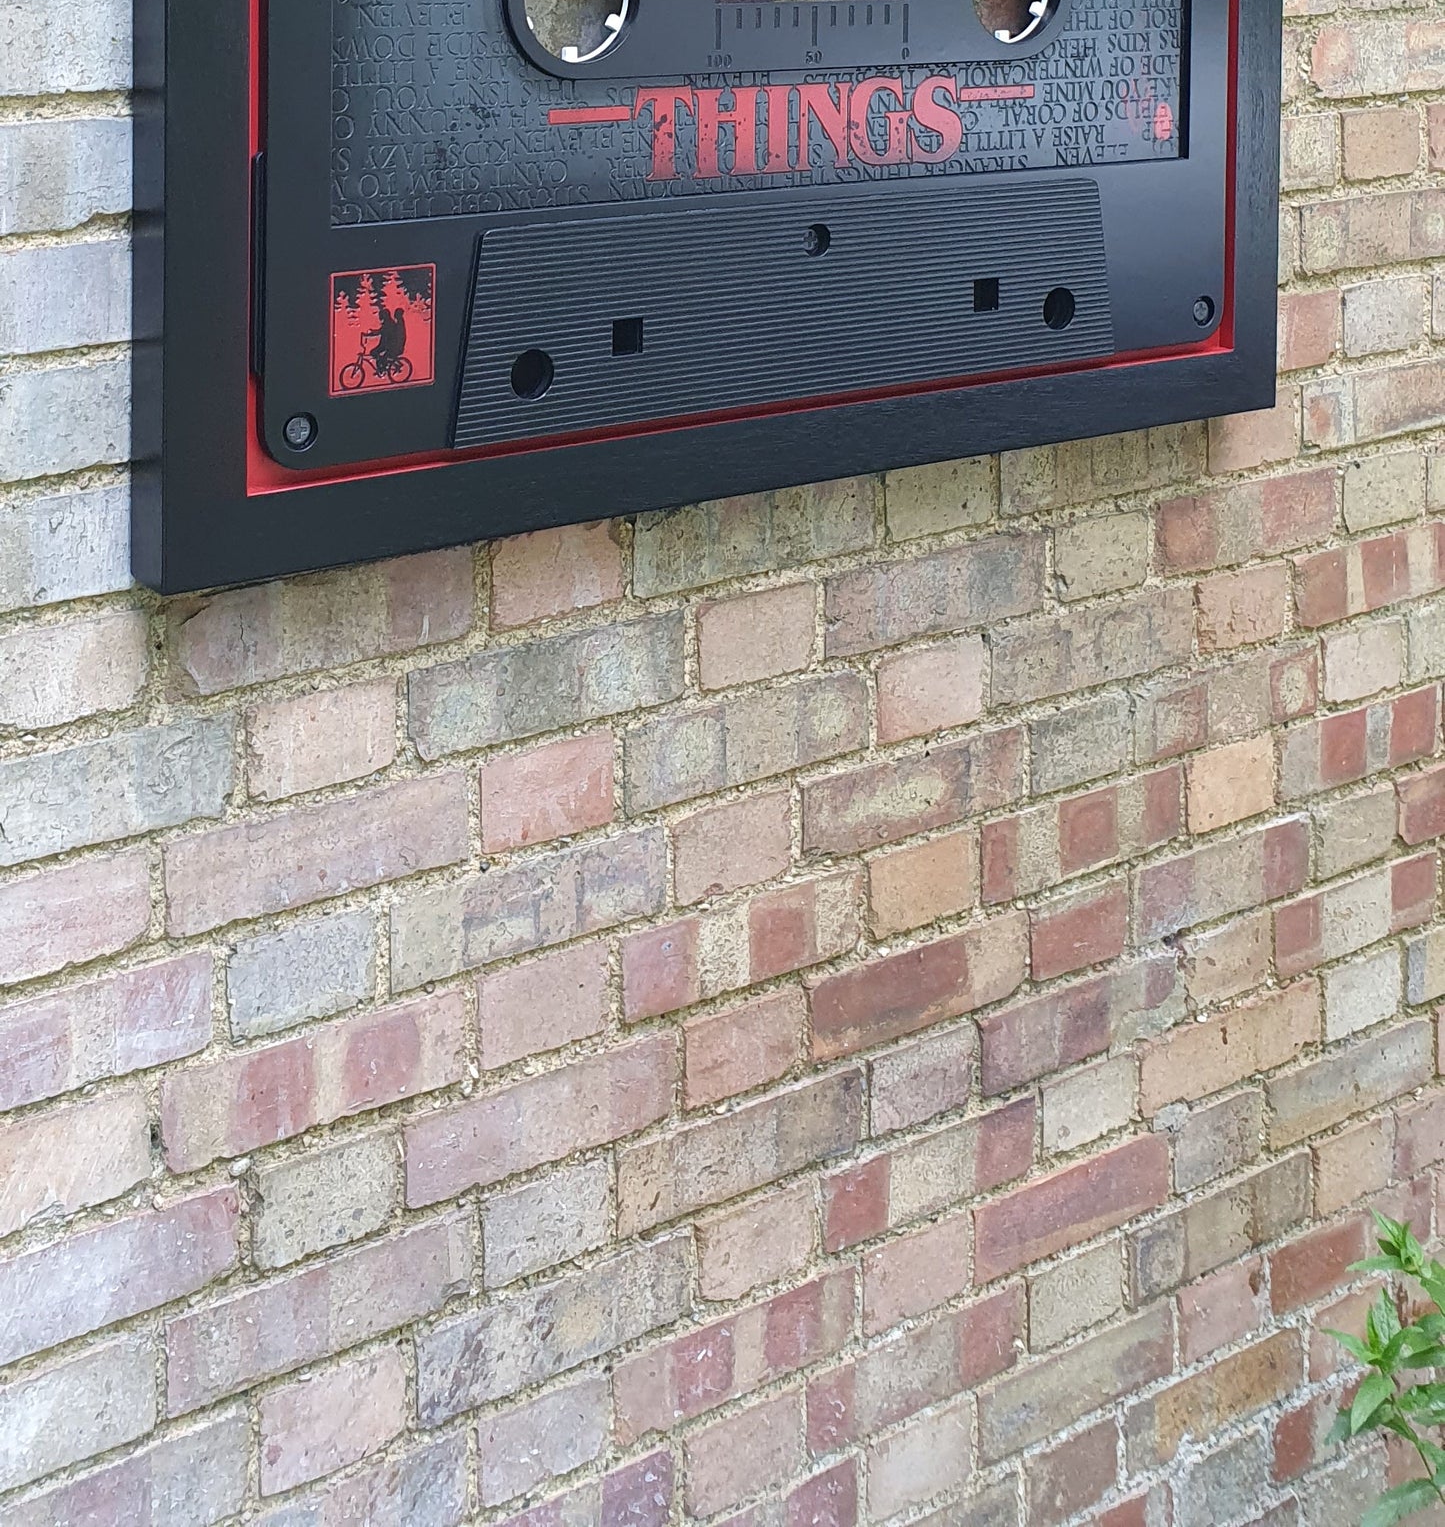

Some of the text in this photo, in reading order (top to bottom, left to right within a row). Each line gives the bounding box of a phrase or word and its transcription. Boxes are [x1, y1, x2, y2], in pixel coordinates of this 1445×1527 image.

[355, 3, 466, 30] ELEVEN
[1108, 9, 1135, 31] OF
[901, 46, 910, 60] 0
[1107, 32, 1152, 55] KIDS
[706, 53, 733, 68] 100
[805, 50, 823, 65] 50
[1108, 55, 1136, 78] OF
[424, 57, 444, 85] A
[370, 84, 434, 114] YOU
[1043, 80, 1096, 105] MINE
[1100, 78, 1142, 102] YOU
[1003, 102, 1068, 129] CORAL
[1071, 100, 1100, 124] OF
[365, 110, 463, 140] FUNNY
[633, 74, 963, 183] THINGS
[1052, 124, 1106, 148] RAISE
[1032, 127, 1047, 150] A
[357, 170, 399, 200] TO
[408, 166, 482, 198] SEEM
